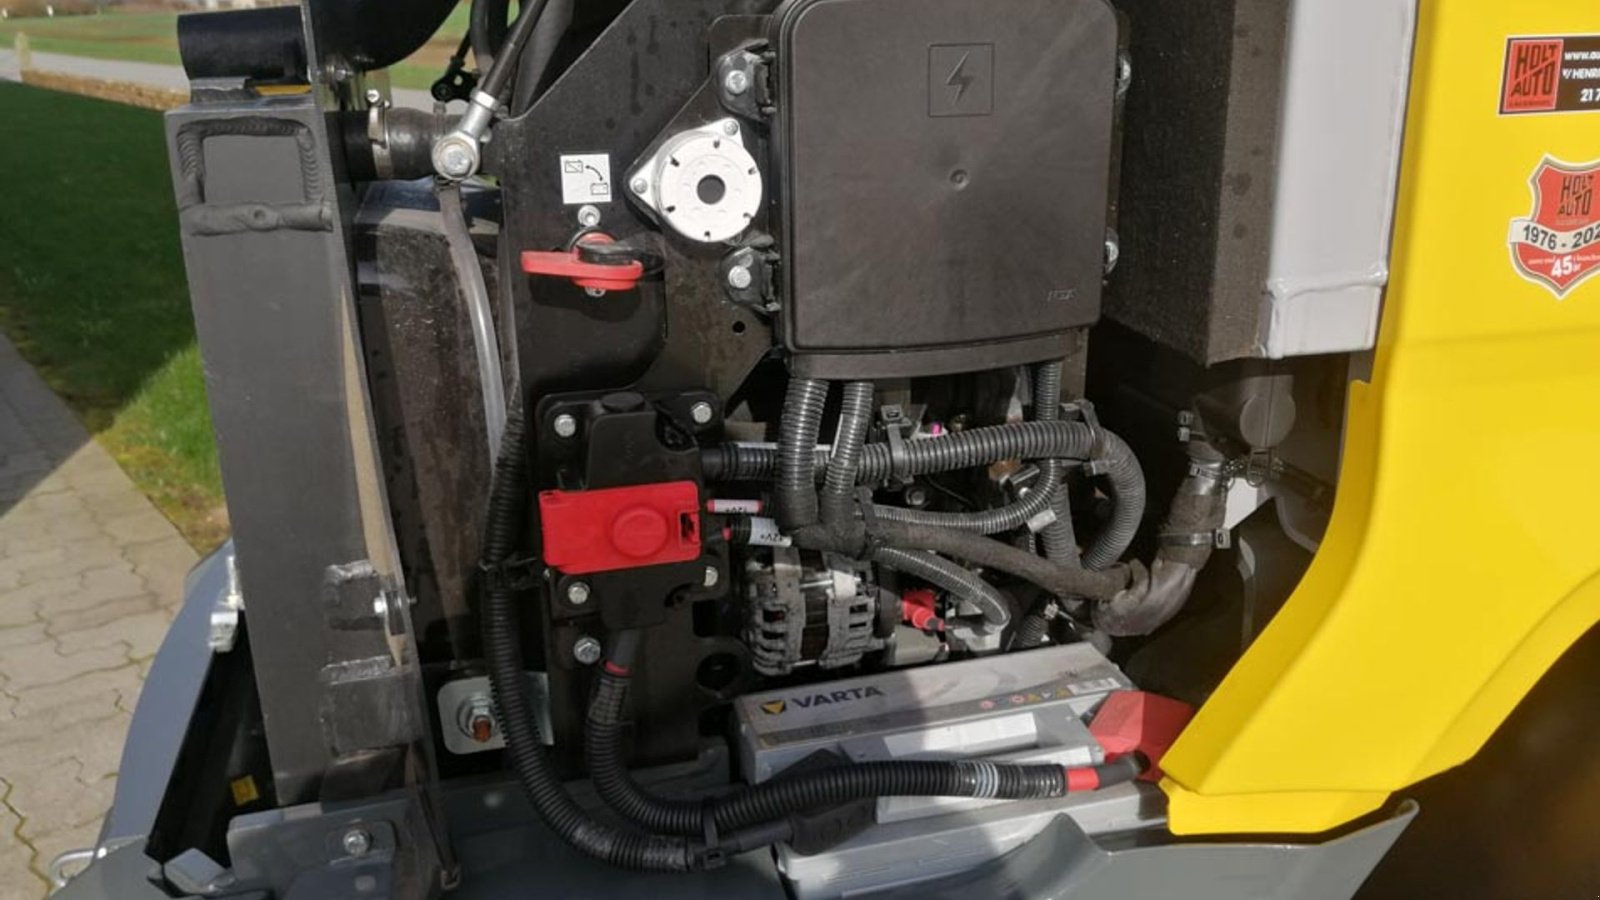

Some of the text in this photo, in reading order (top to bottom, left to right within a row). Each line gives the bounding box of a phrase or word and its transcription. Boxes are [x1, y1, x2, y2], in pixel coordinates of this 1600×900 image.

[1514, 44, 1557, 80] HOLT
[1510, 61, 1556, 97] AUTO
[1580, 88, 1593, 102] 21
[1556, 188, 1593, 216] AUTO
[1560, 174, 1594, 203] HOLT
[1523, 224, 1557, 250] 1976
[791, 686, 886, 708] VARTA
